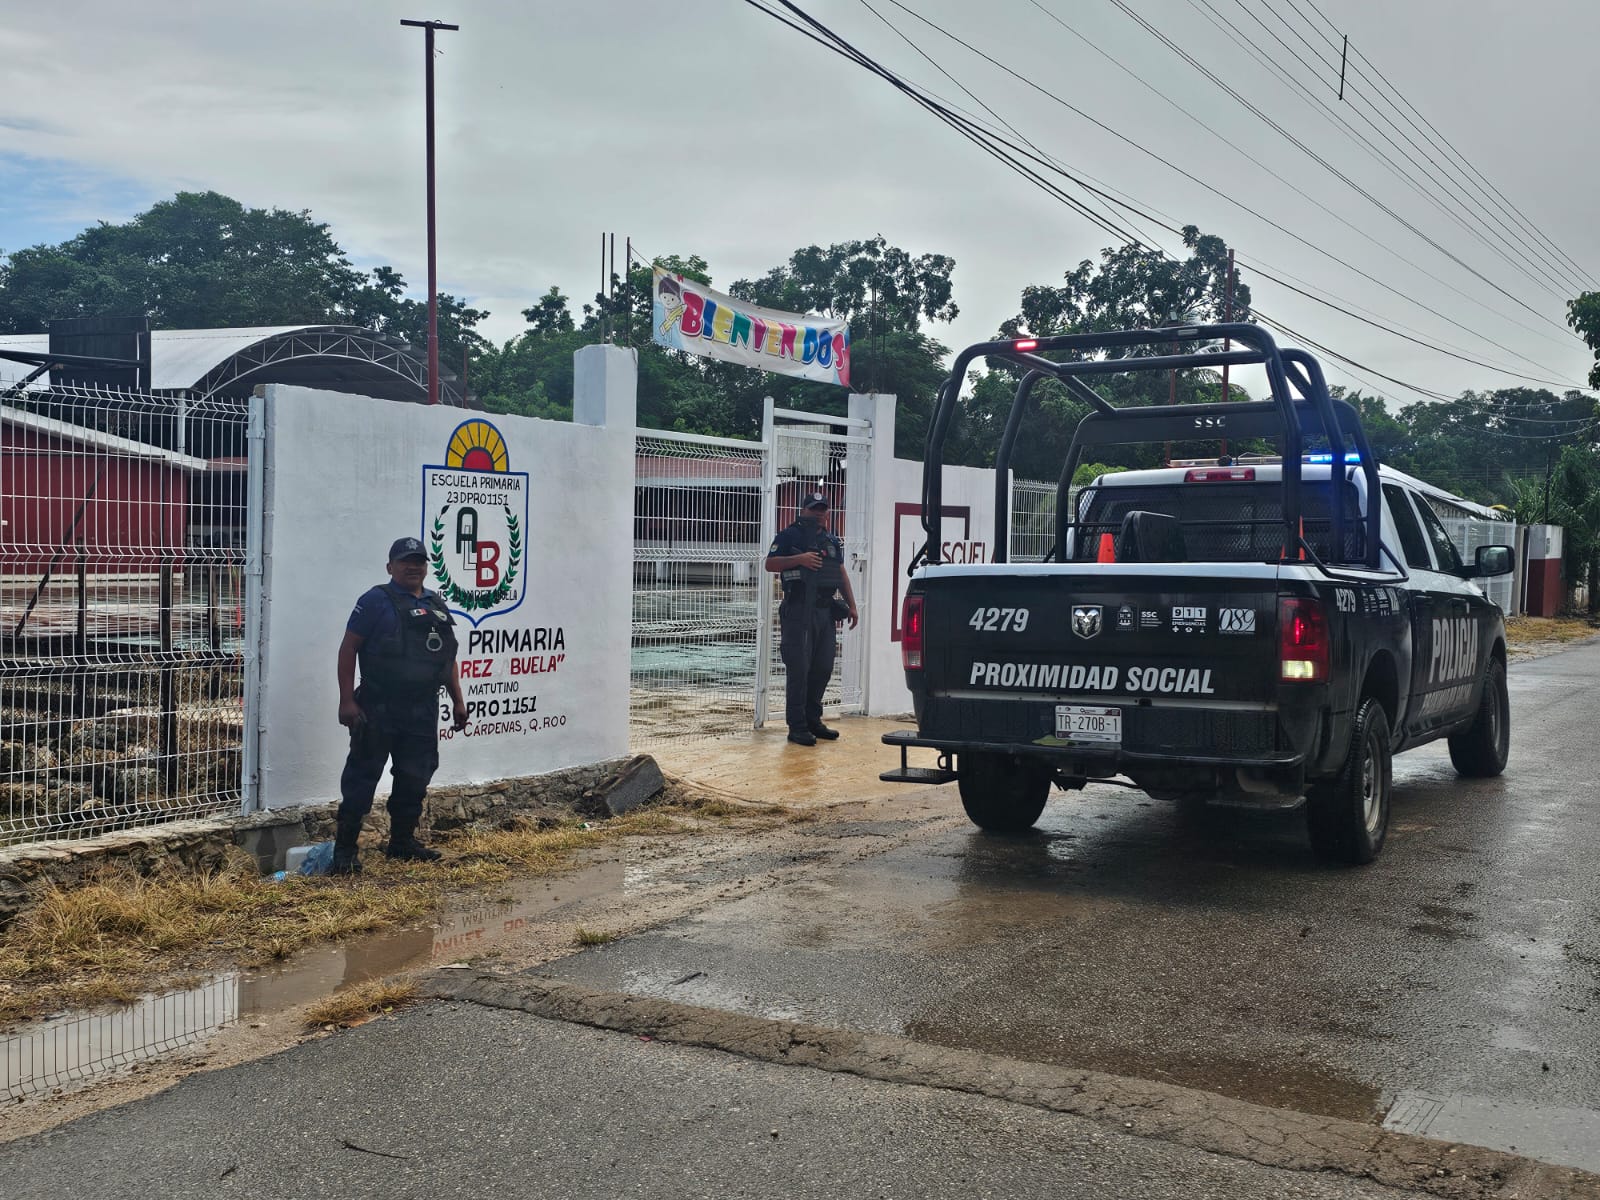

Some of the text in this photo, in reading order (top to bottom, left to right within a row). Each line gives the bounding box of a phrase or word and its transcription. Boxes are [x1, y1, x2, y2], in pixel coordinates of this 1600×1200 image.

[680, 290, 847, 370] BIENVENIDOS
[1193, 415, 1226, 428] SSC
[431, 473, 521, 491] ESCUELA PRIMARIA
[968, 607, 1030, 632] 4279
[1173, 607, 1205, 618] 911
[1219, 608, 1256, 632] 089
[469, 627, 565, 655] PRIMARIA
[468, 681, 519, 696] MATUTINO
[970, 662, 1215, 694] PROXIMIDAD SOCIAL
